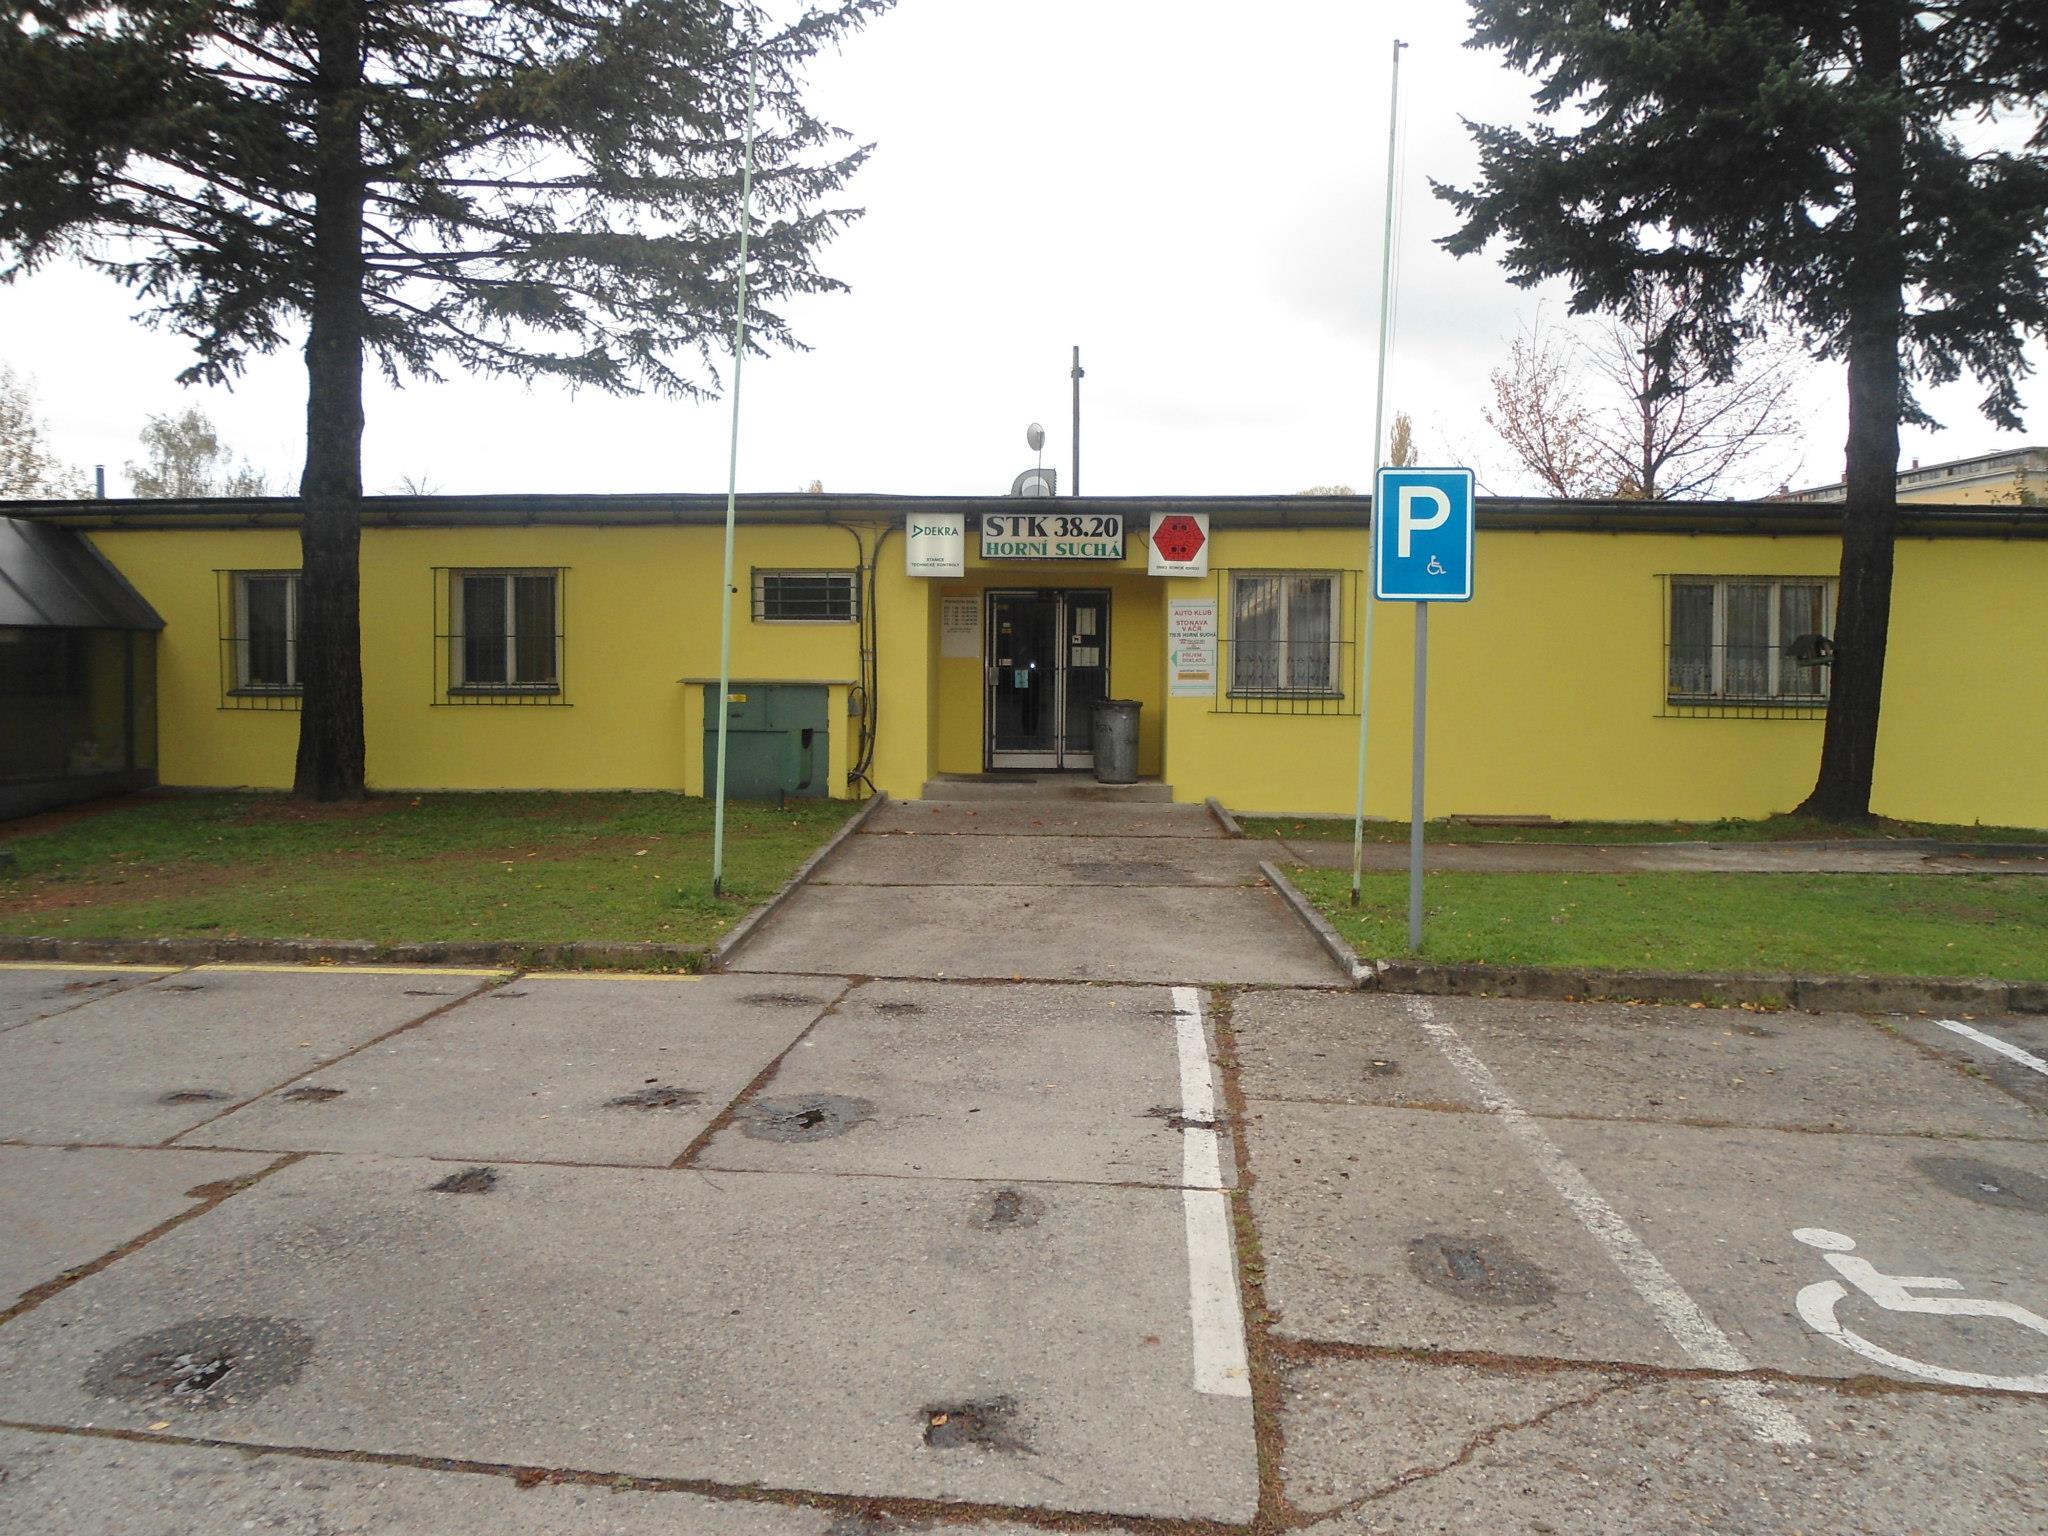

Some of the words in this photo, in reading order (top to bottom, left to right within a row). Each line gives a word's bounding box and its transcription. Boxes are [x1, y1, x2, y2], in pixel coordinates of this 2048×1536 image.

[924, 526, 959, 536] DEKRA
[986, 516, 1048, 537] STK
[1054, 517, 1119, 537] 38.20
[1398, 486, 1451, 558] P
[986, 540, 1048, 556] HORNÍ
[1055, 541, 1121, 557] SUCHÁ
